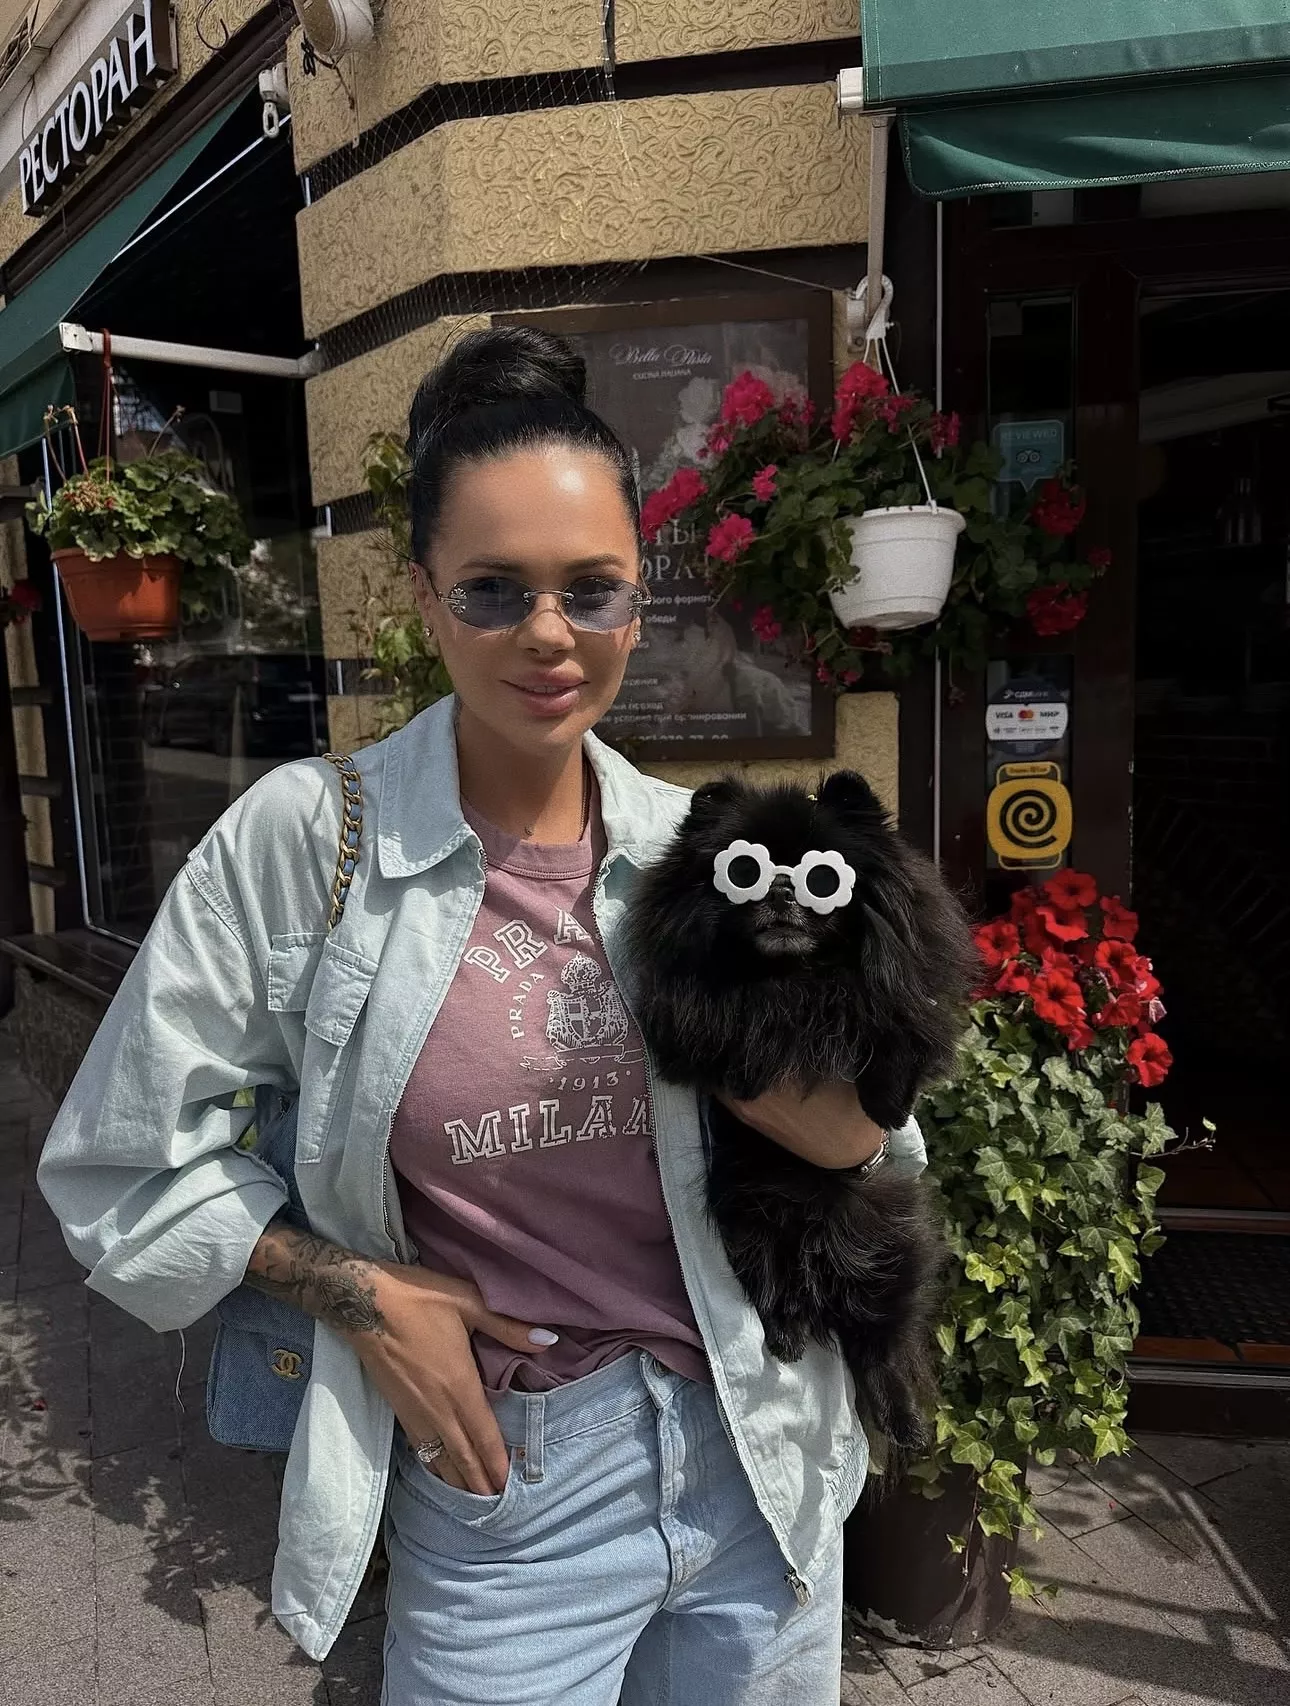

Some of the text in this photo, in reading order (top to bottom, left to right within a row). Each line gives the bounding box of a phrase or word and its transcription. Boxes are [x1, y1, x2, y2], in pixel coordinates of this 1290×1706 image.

[19, 0, 156, 215] РЕСТОРАН
[995, 711, 1013, 719] VISA
[509, 972, 545, 1040] PRADA
[443, 1095, 653, 1165] MILAN
